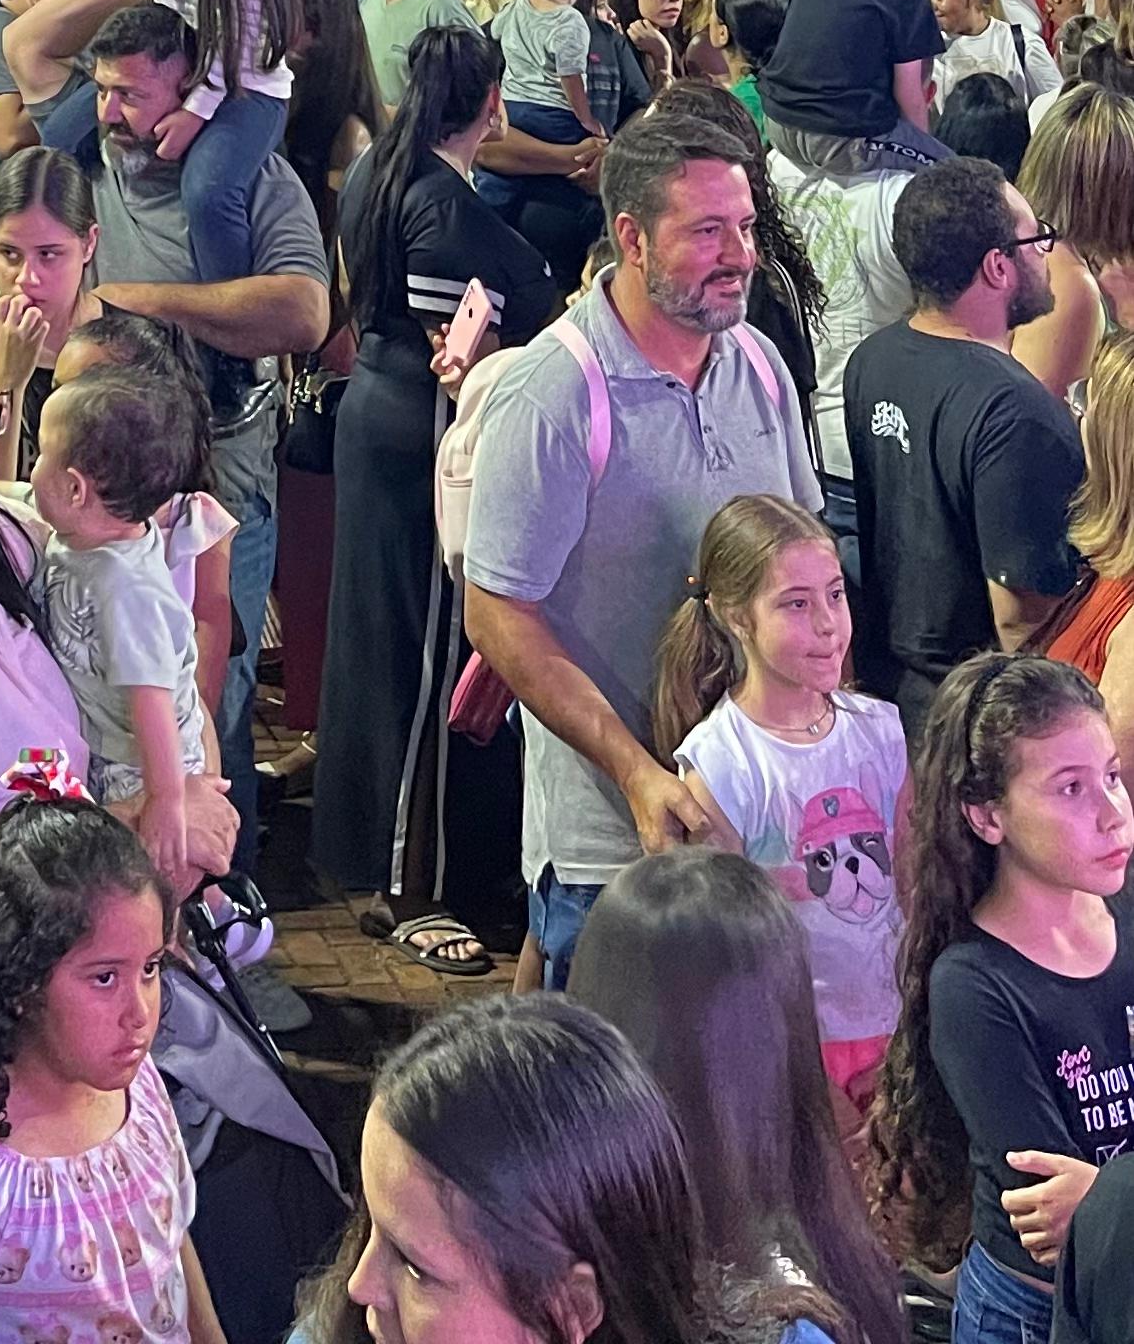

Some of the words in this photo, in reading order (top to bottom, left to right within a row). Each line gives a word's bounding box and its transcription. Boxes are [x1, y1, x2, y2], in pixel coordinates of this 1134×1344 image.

[1076, 1074, 1101, 1102] DO
[1099, 1065, 1129, 1096] YOU
[1080, 1105, 1105, 1133] TO
[1107, 1099, 1128, 1128] BE
